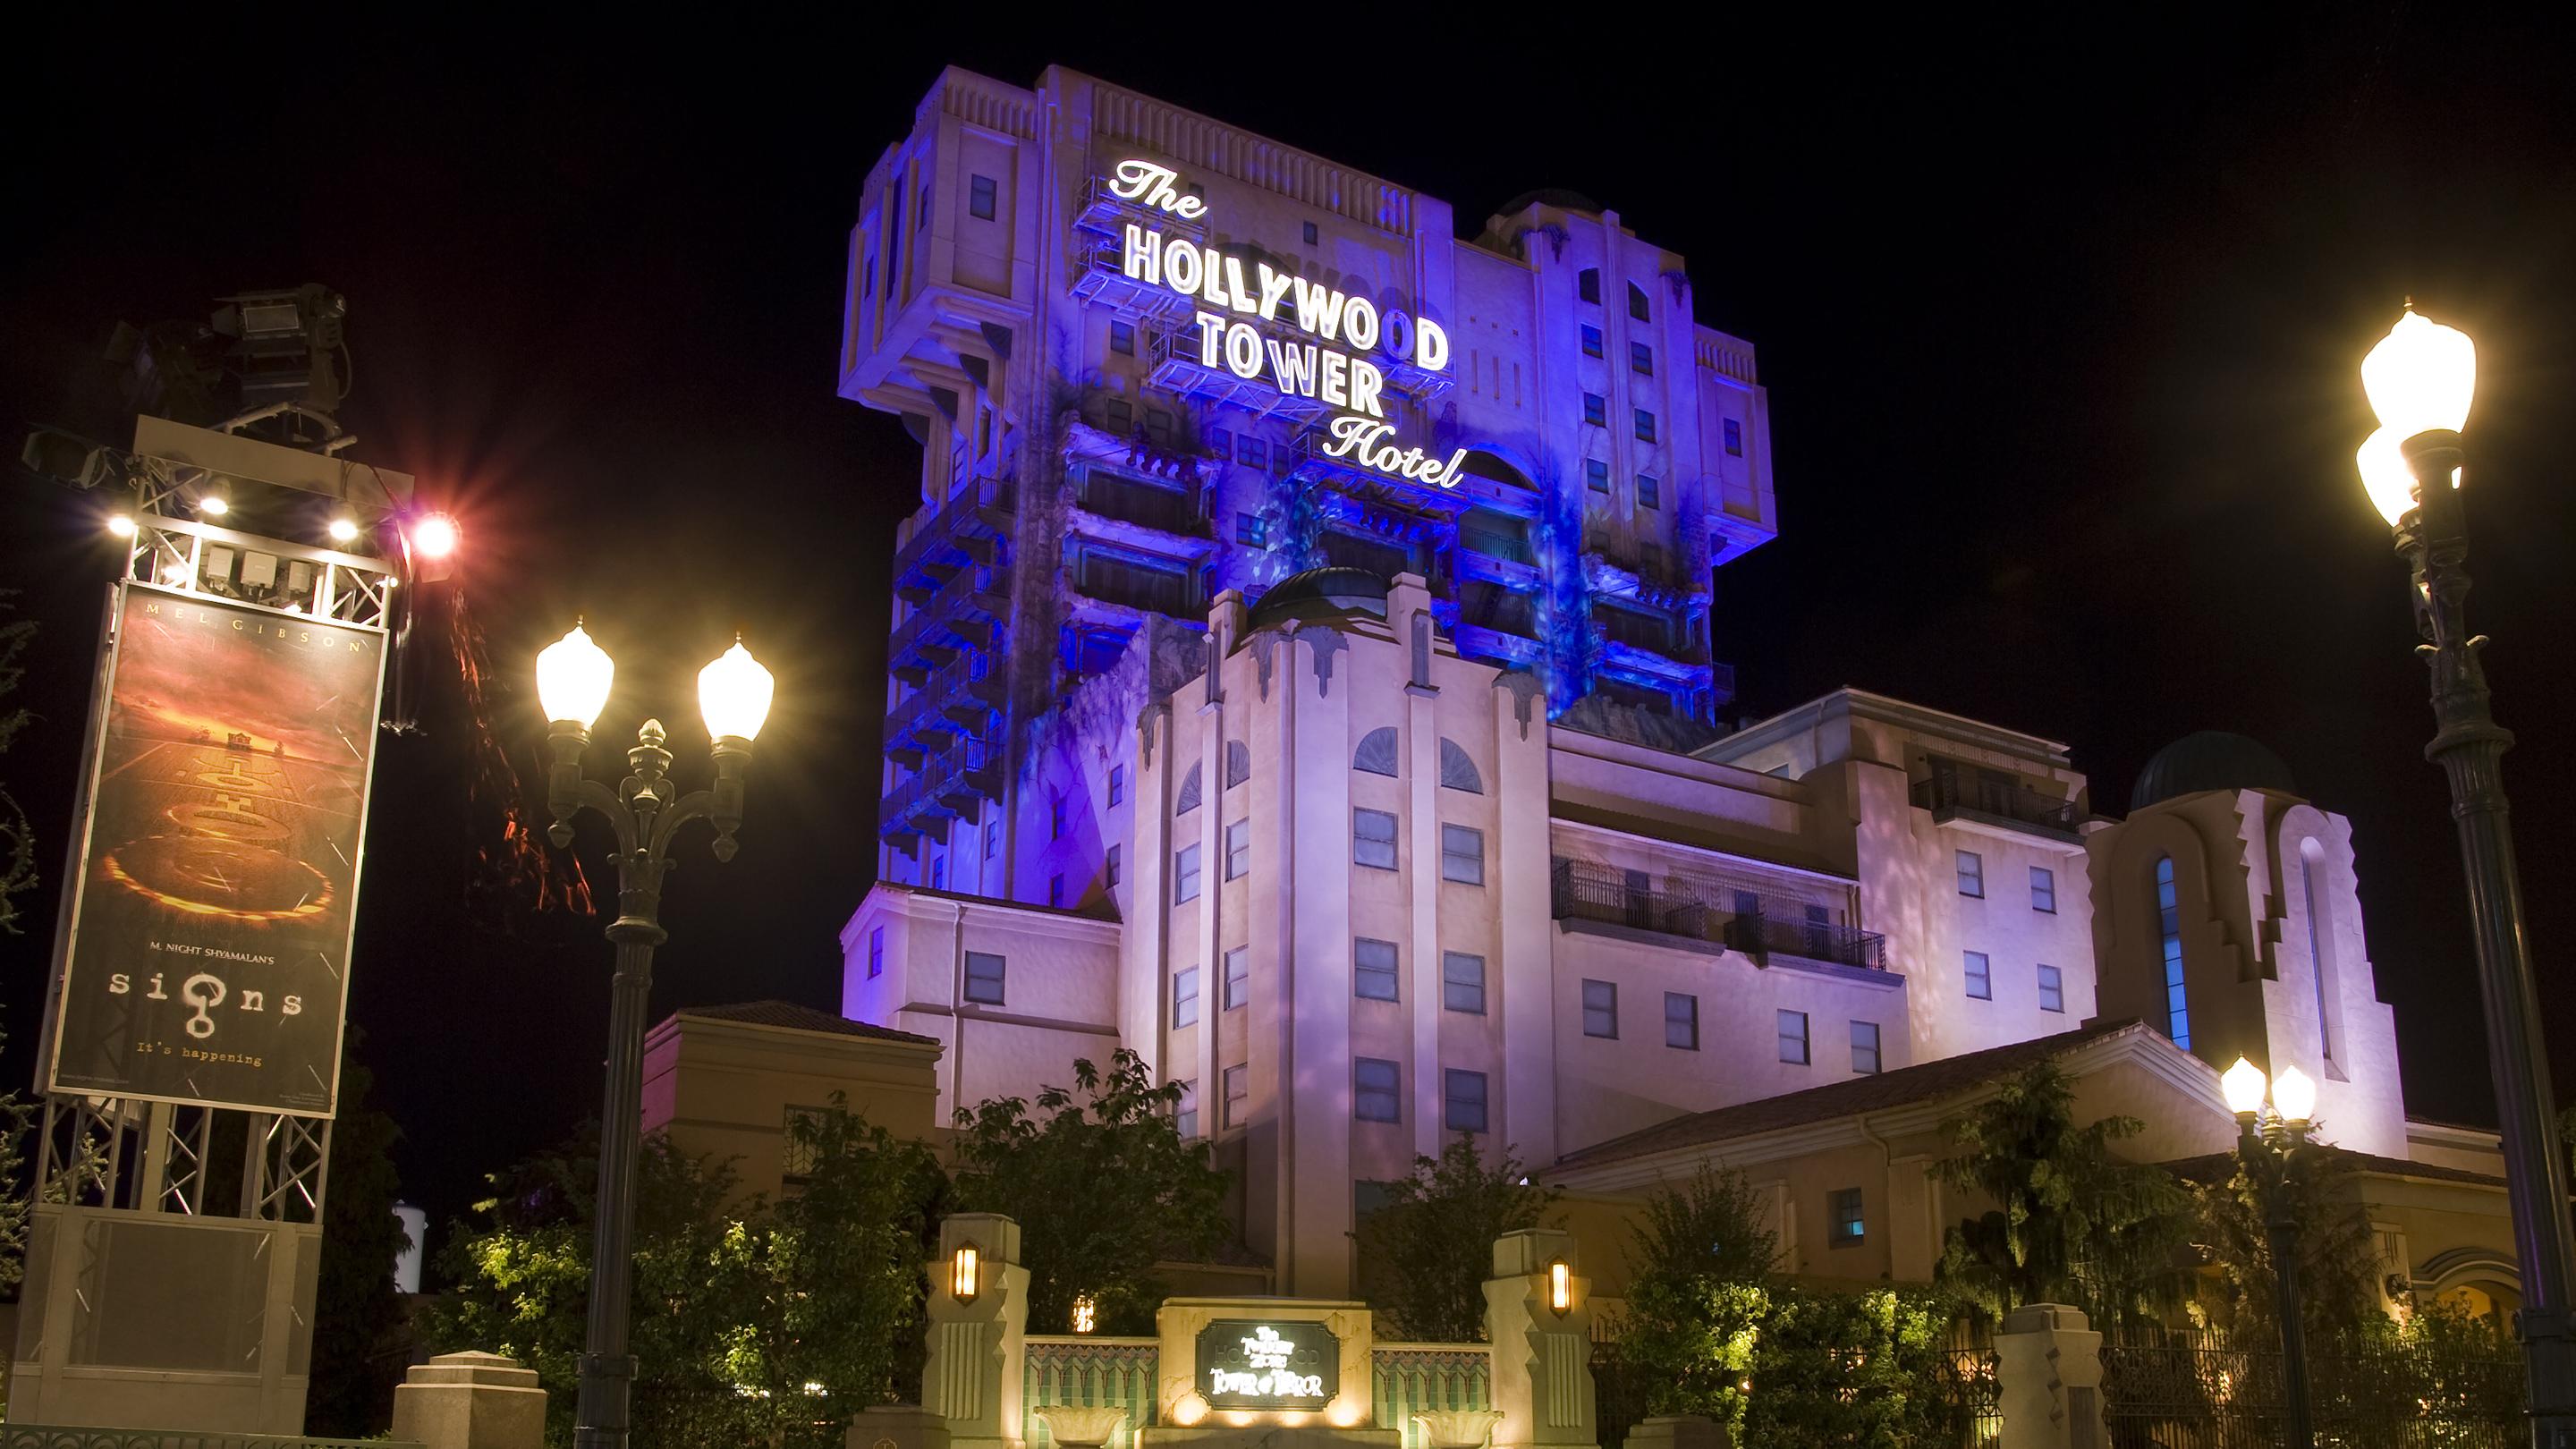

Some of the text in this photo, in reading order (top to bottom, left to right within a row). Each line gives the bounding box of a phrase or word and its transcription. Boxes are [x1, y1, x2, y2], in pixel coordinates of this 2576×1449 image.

[1109, 159, 1208, 219] The
[1123, 223, 1450, 372] HOLLYWOOD
[1195, 310, 1385, 418] TOWER
[1322, 415, 1468, 489] Hotel
[146, 604, 360, 653] MEL GIBSON
[149, 941, 275, 965] M. NIGHT SHYAMALAN'S
[109, 971, 302, 1038] signs
[136, 1040, 263, 1068] It's happening
